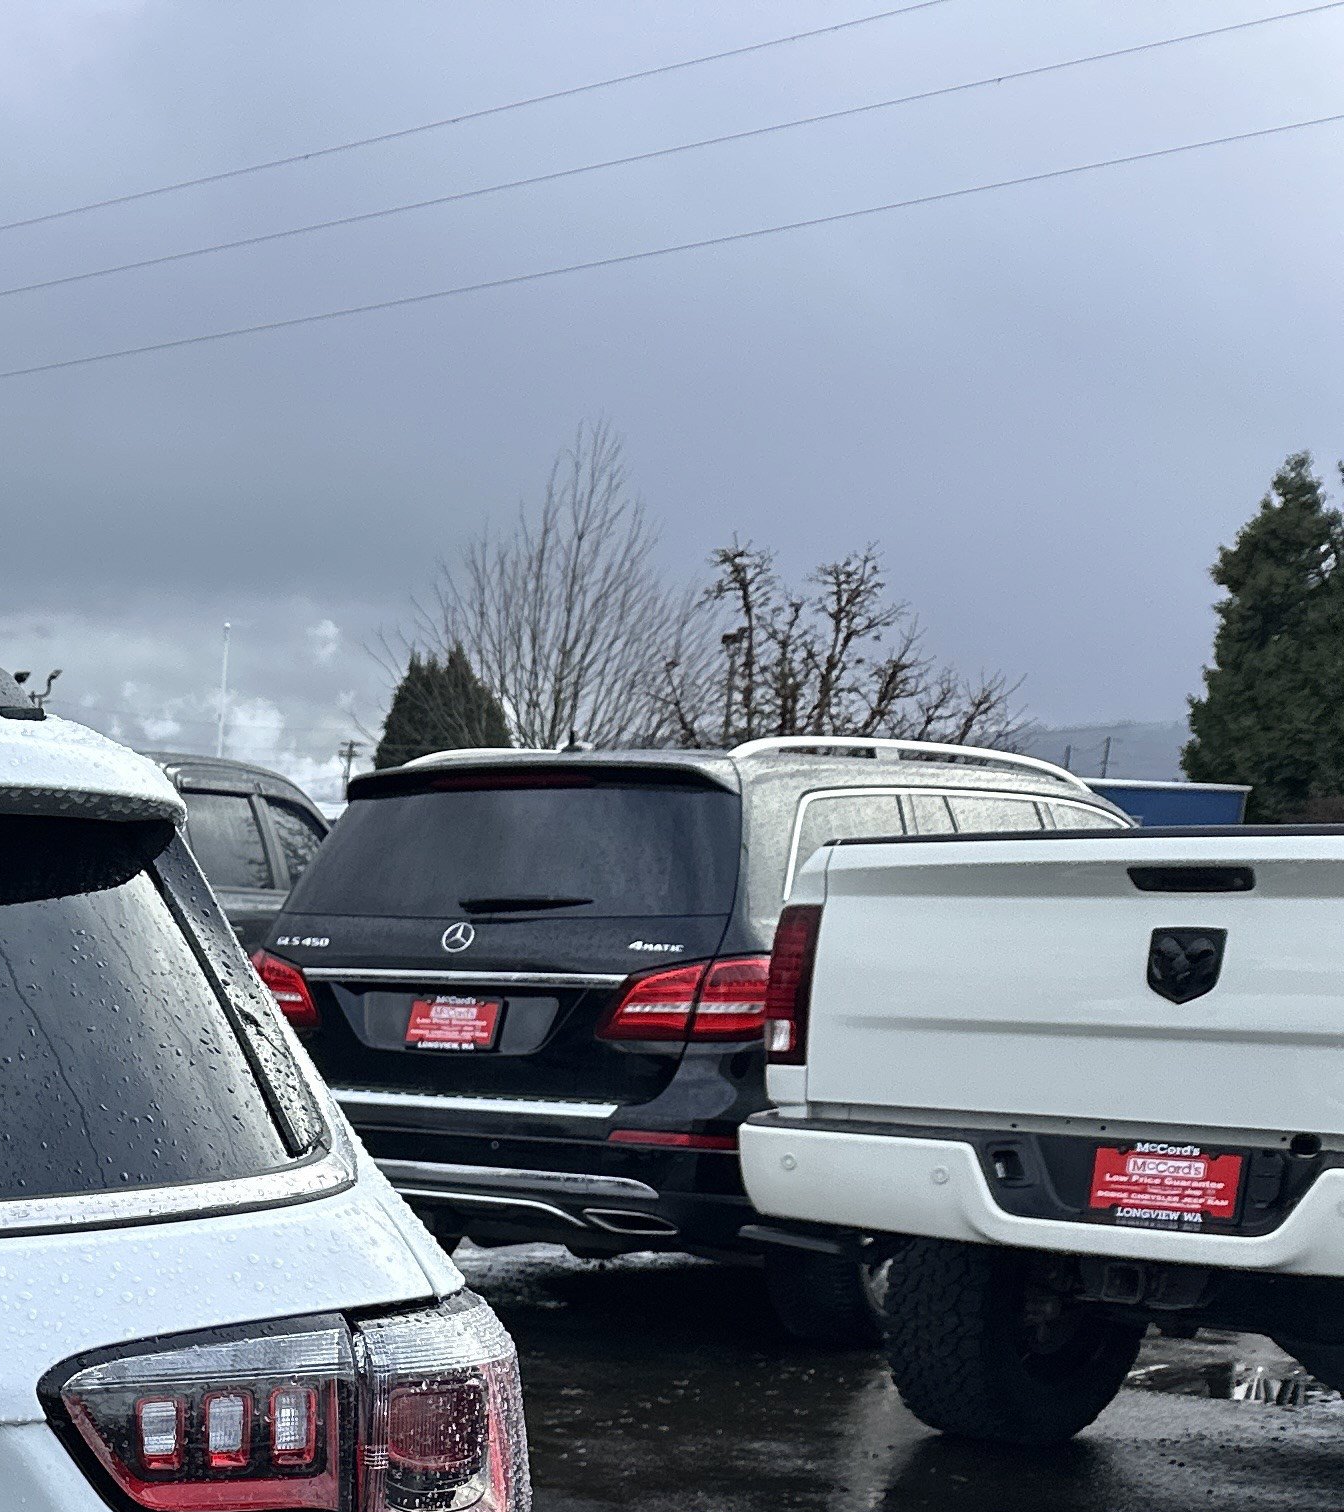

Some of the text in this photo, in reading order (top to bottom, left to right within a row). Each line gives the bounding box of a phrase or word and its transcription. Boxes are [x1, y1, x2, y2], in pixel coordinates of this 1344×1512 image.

[1135, 1142, 1200, 1156] McCord's
[1131, 1159, 1202, 1176] McCord's
[1116, 1207, 1203, 1223] LONGVIEW WA
